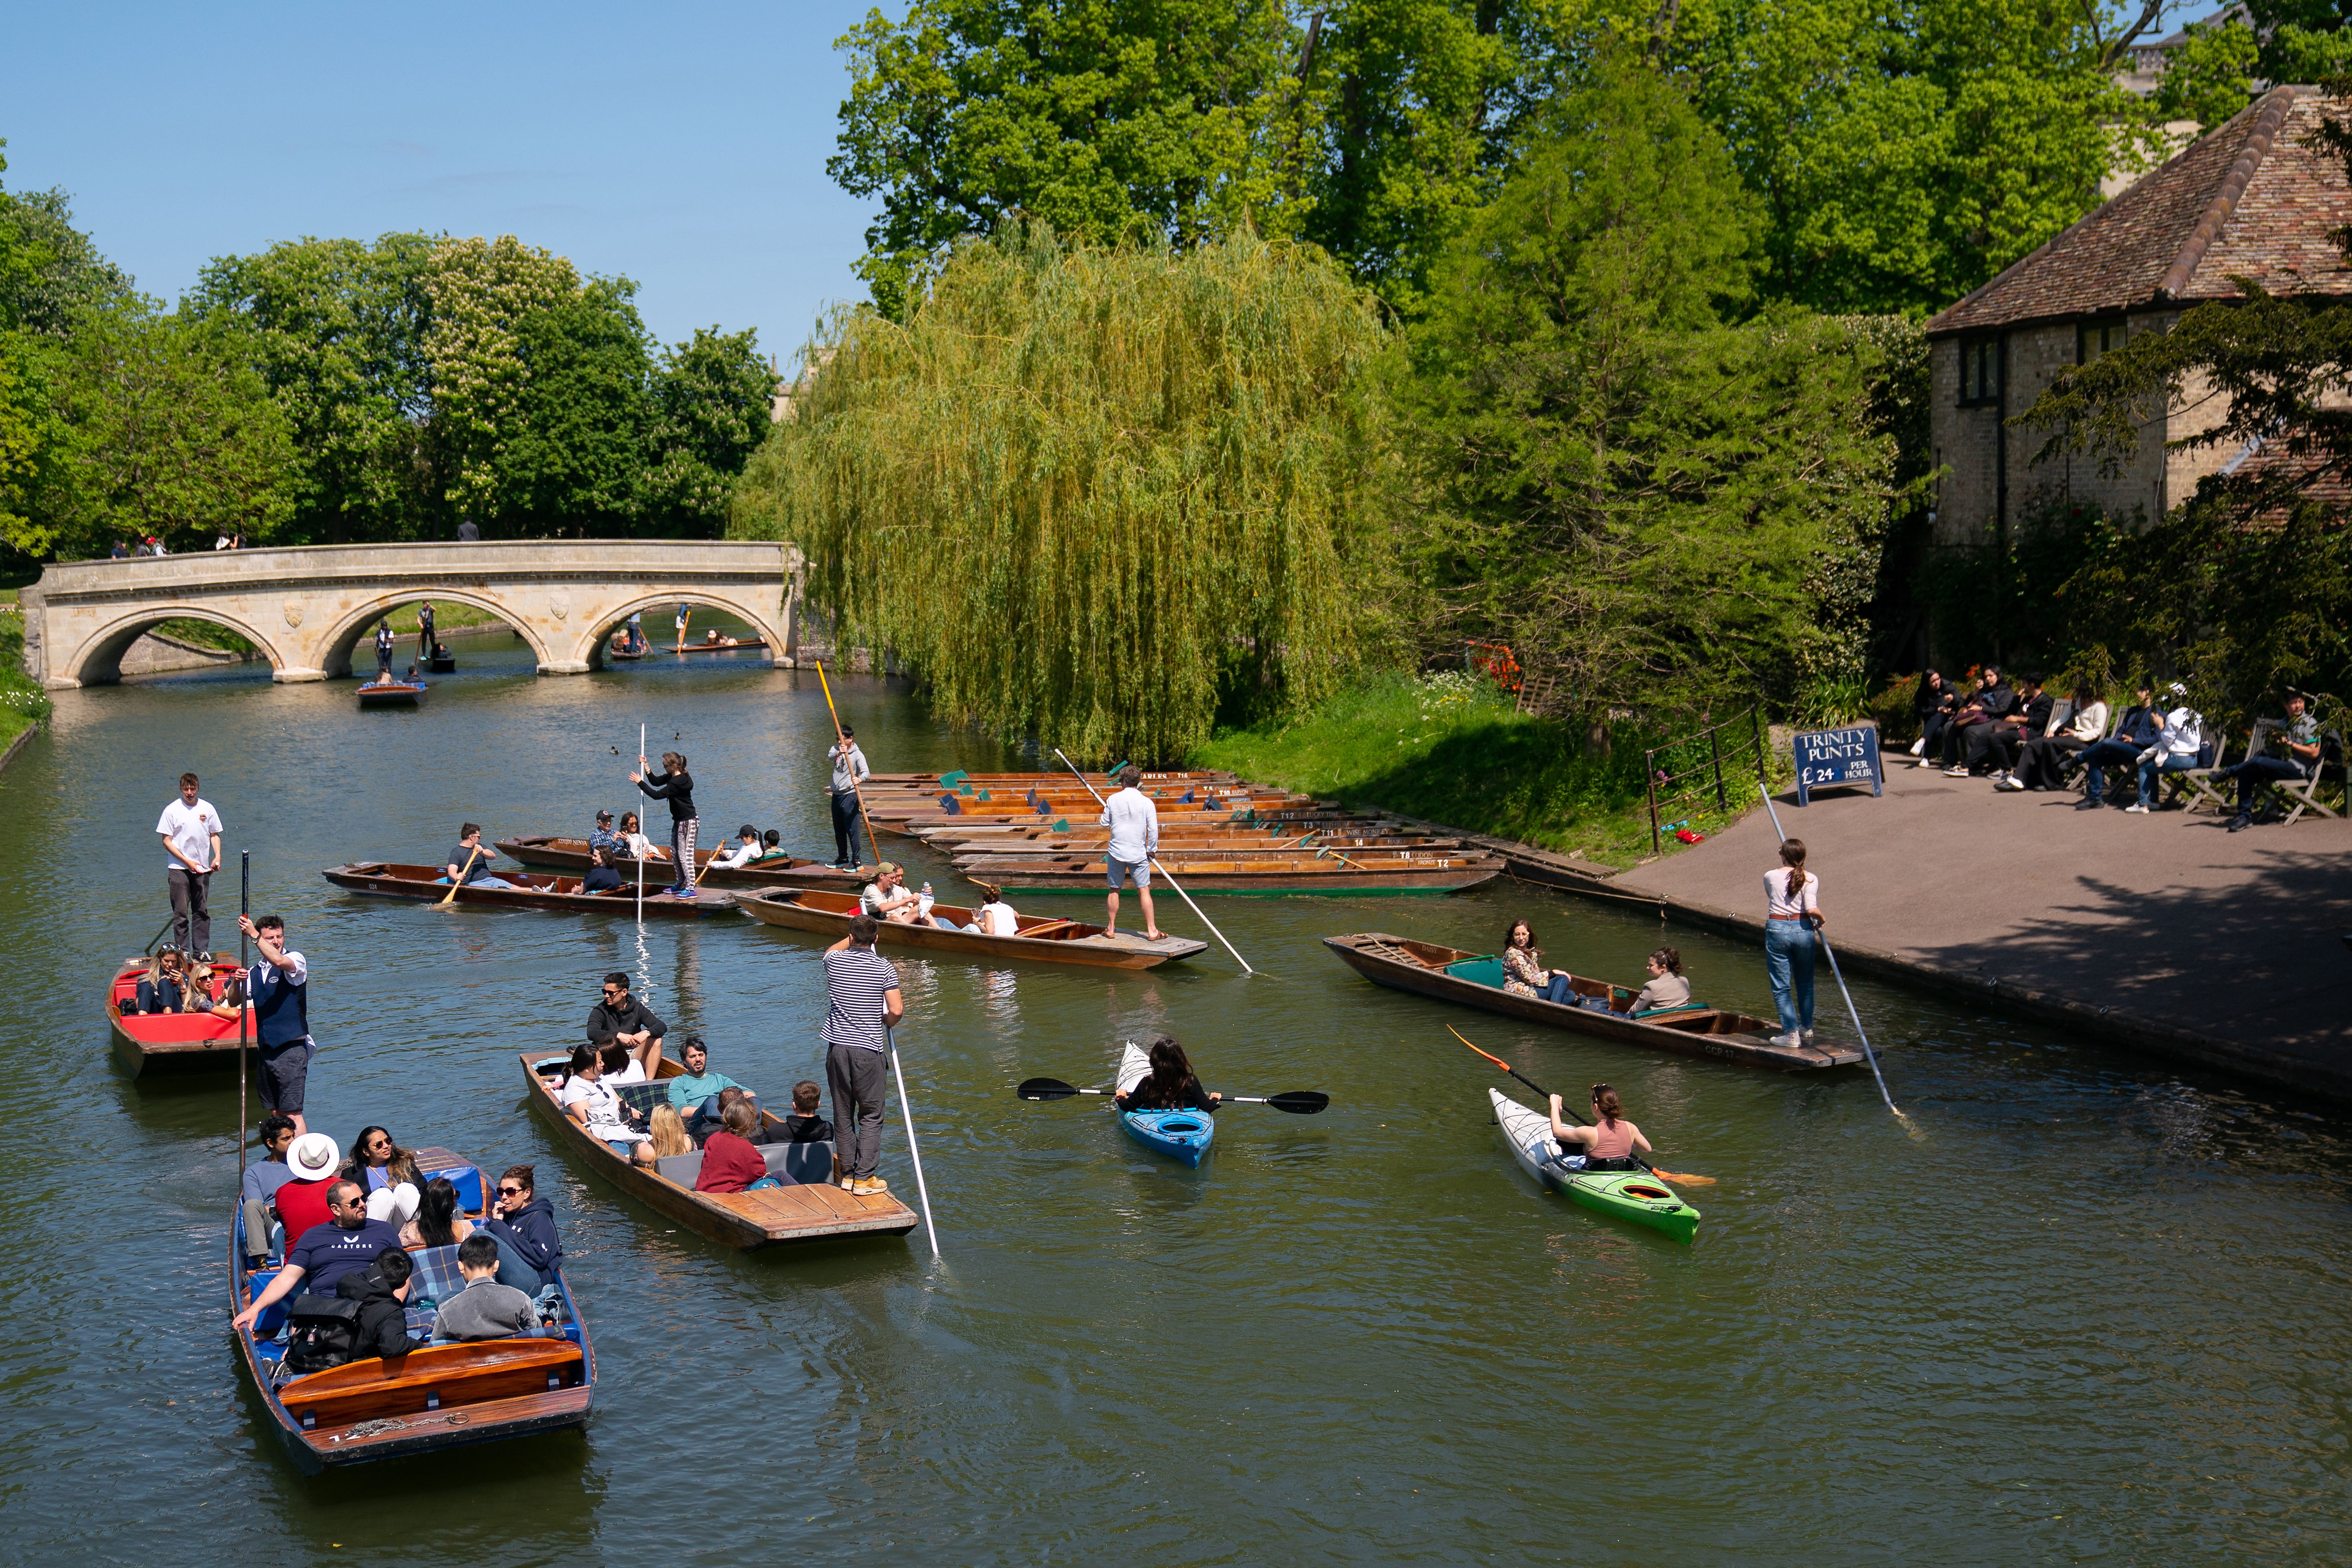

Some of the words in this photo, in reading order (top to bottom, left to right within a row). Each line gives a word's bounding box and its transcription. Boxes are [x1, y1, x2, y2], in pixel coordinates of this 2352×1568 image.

[1800, 728, 1868, 748] TRINITY
[1808, 743, 1864, 761] PUNTS
[1850, 760, 1868, 770] PER
[1817, 768, 1835, 782] 24
[1845, 768, 1873, 779] HOUR
[1422, 945, 1437, 954] DAISY
[1705, 1045, 1722, 1055] CCP
[1725, 1050, 1734, 1059] 17
